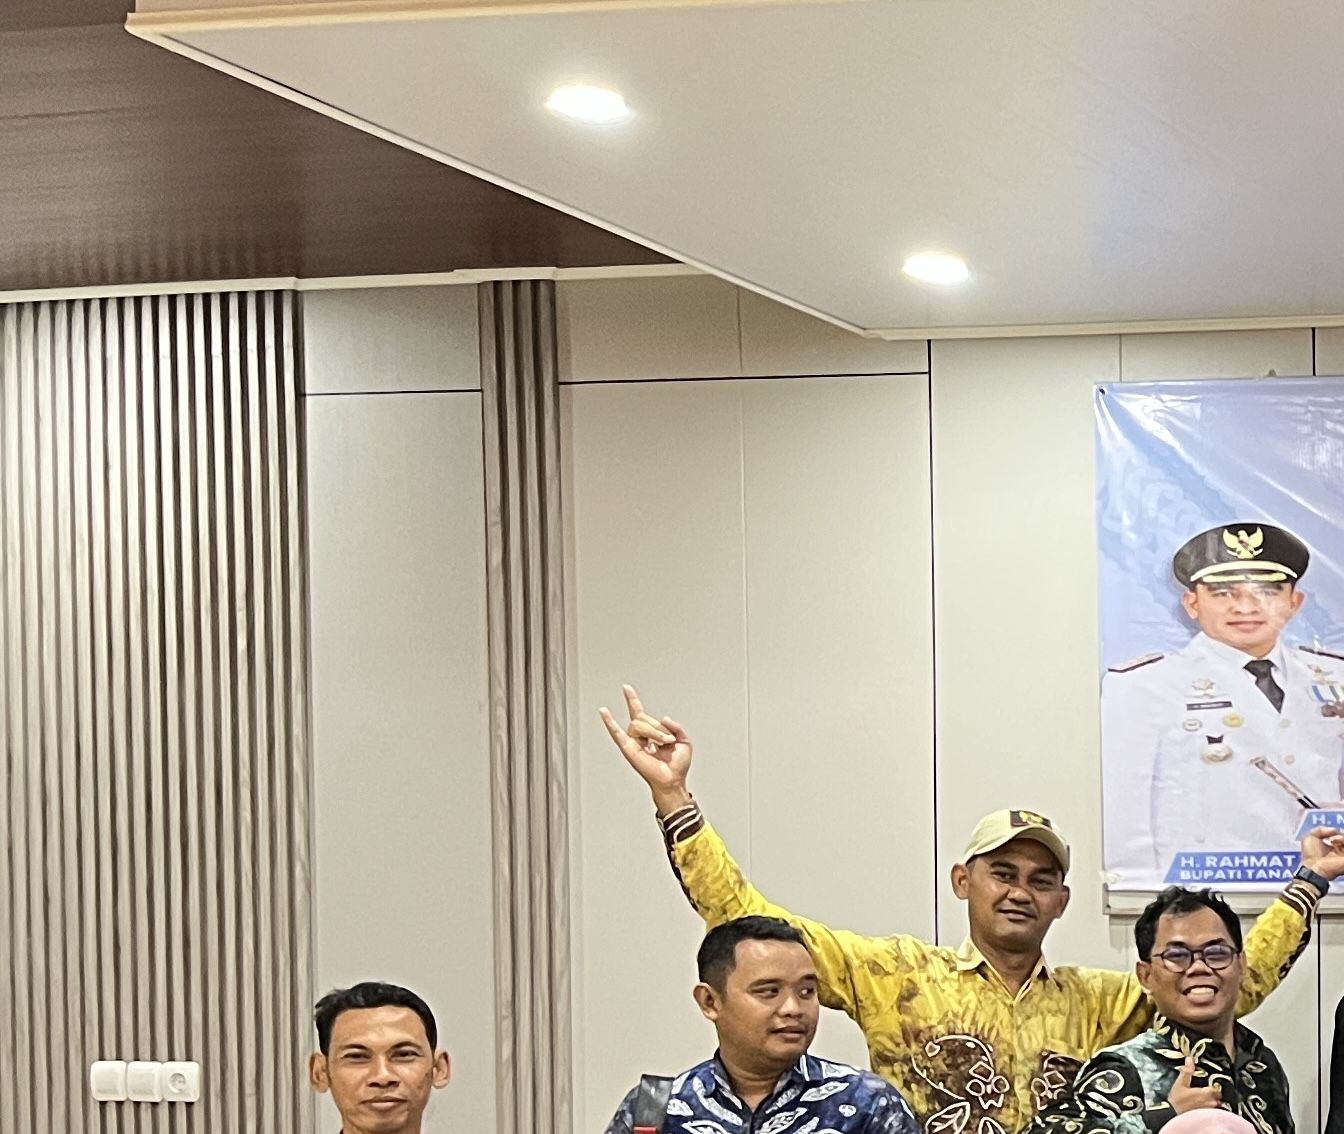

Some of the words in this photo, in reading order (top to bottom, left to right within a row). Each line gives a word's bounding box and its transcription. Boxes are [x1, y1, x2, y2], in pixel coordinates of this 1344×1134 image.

[1311, 813, 1331, 825] H.
[1181, 856, 1201, 868] H.
[1206, 855, 1296, 868] RAHMAT
[1180, 869, 1242, 880] BUPATI
[1248, 868, 1298, 880] TANA
